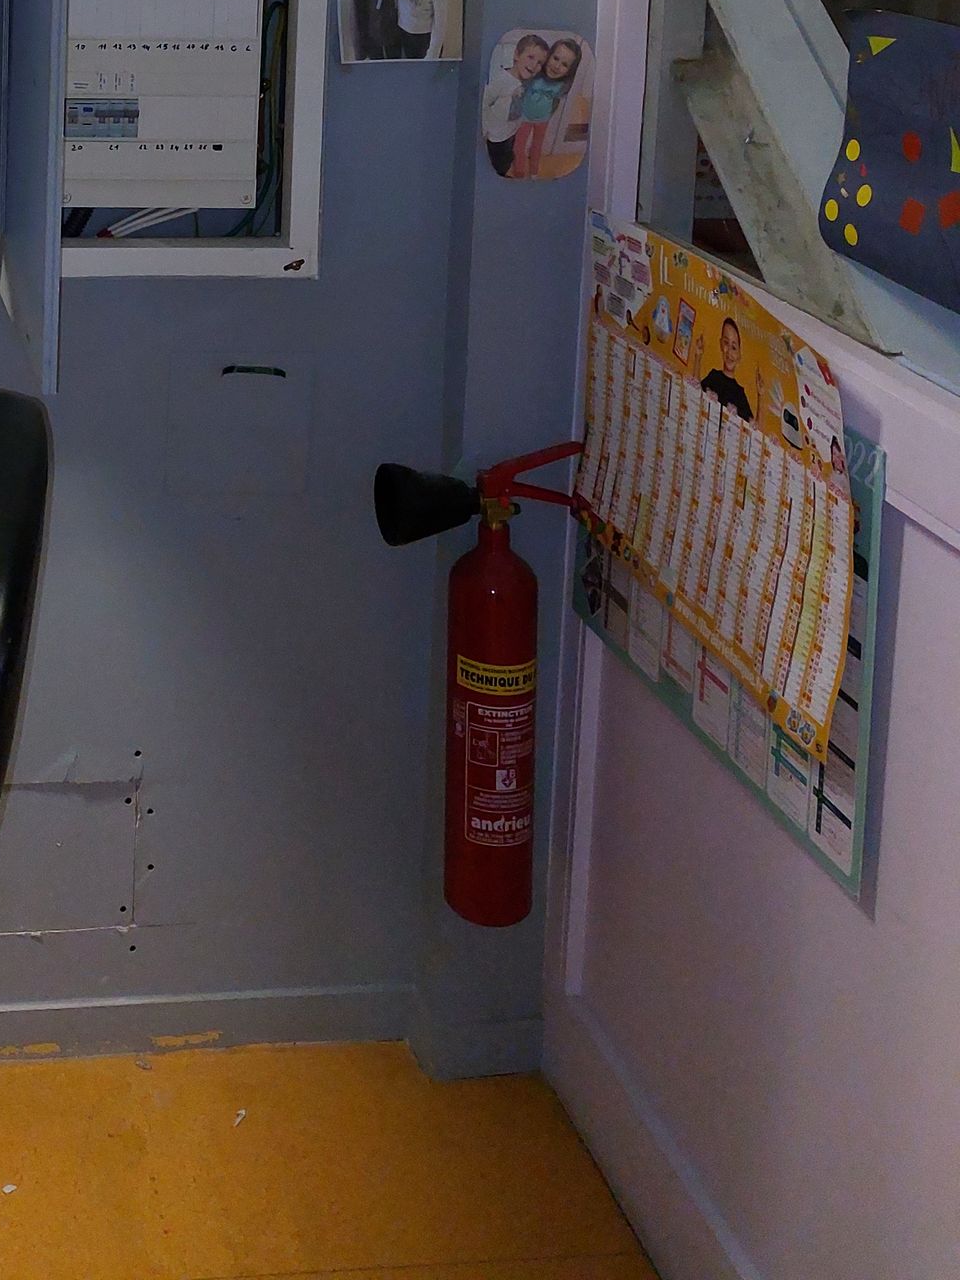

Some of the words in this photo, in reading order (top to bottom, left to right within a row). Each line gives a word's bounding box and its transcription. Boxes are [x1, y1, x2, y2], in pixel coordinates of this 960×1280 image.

[74, 43, 86, 51] 10
[112, 43, 123, 51] 12
[126, 43, 137, 51] 13
[155, 43, 169, 51] 15
[71, 144, 83, 152] 20
[459, 666, 520, 688] TECHNIQUE
[522, 673, 533, 685] DU
